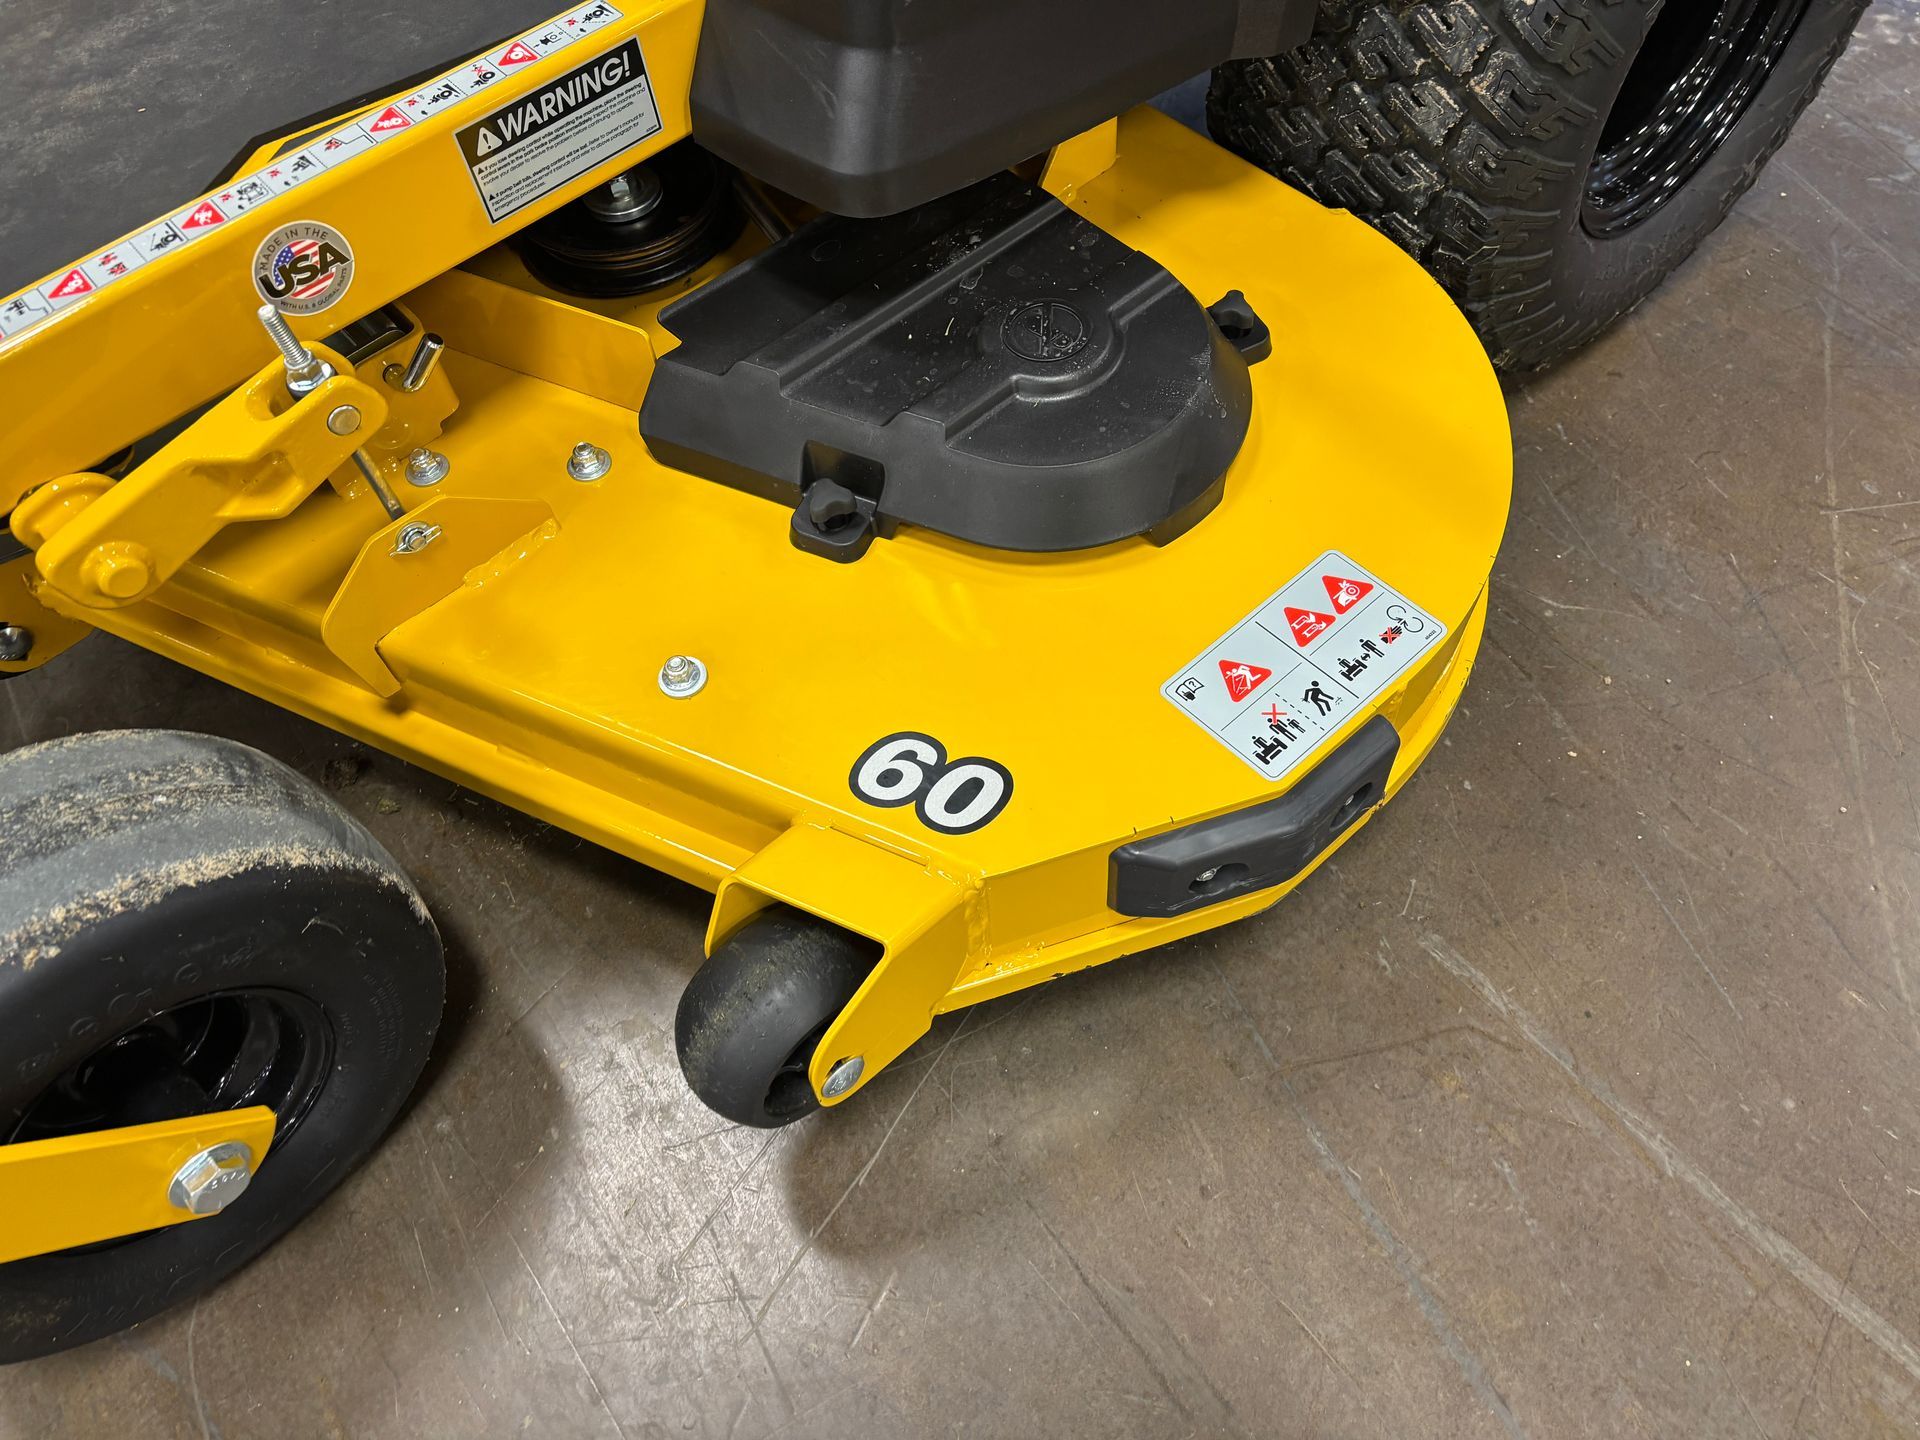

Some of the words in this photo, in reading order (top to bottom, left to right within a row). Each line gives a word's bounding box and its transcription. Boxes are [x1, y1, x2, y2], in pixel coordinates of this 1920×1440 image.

[496, 50, 630, 141] WARNING!
[258, 241, 351, 299] USA
[259, 236, 283, 271] MADE
[285, 228, 299, 240] IN
[304, 227, 329, 240] THE
[280, 301, 298, 310] WITH
[852, 734, 1010, 833] 60
